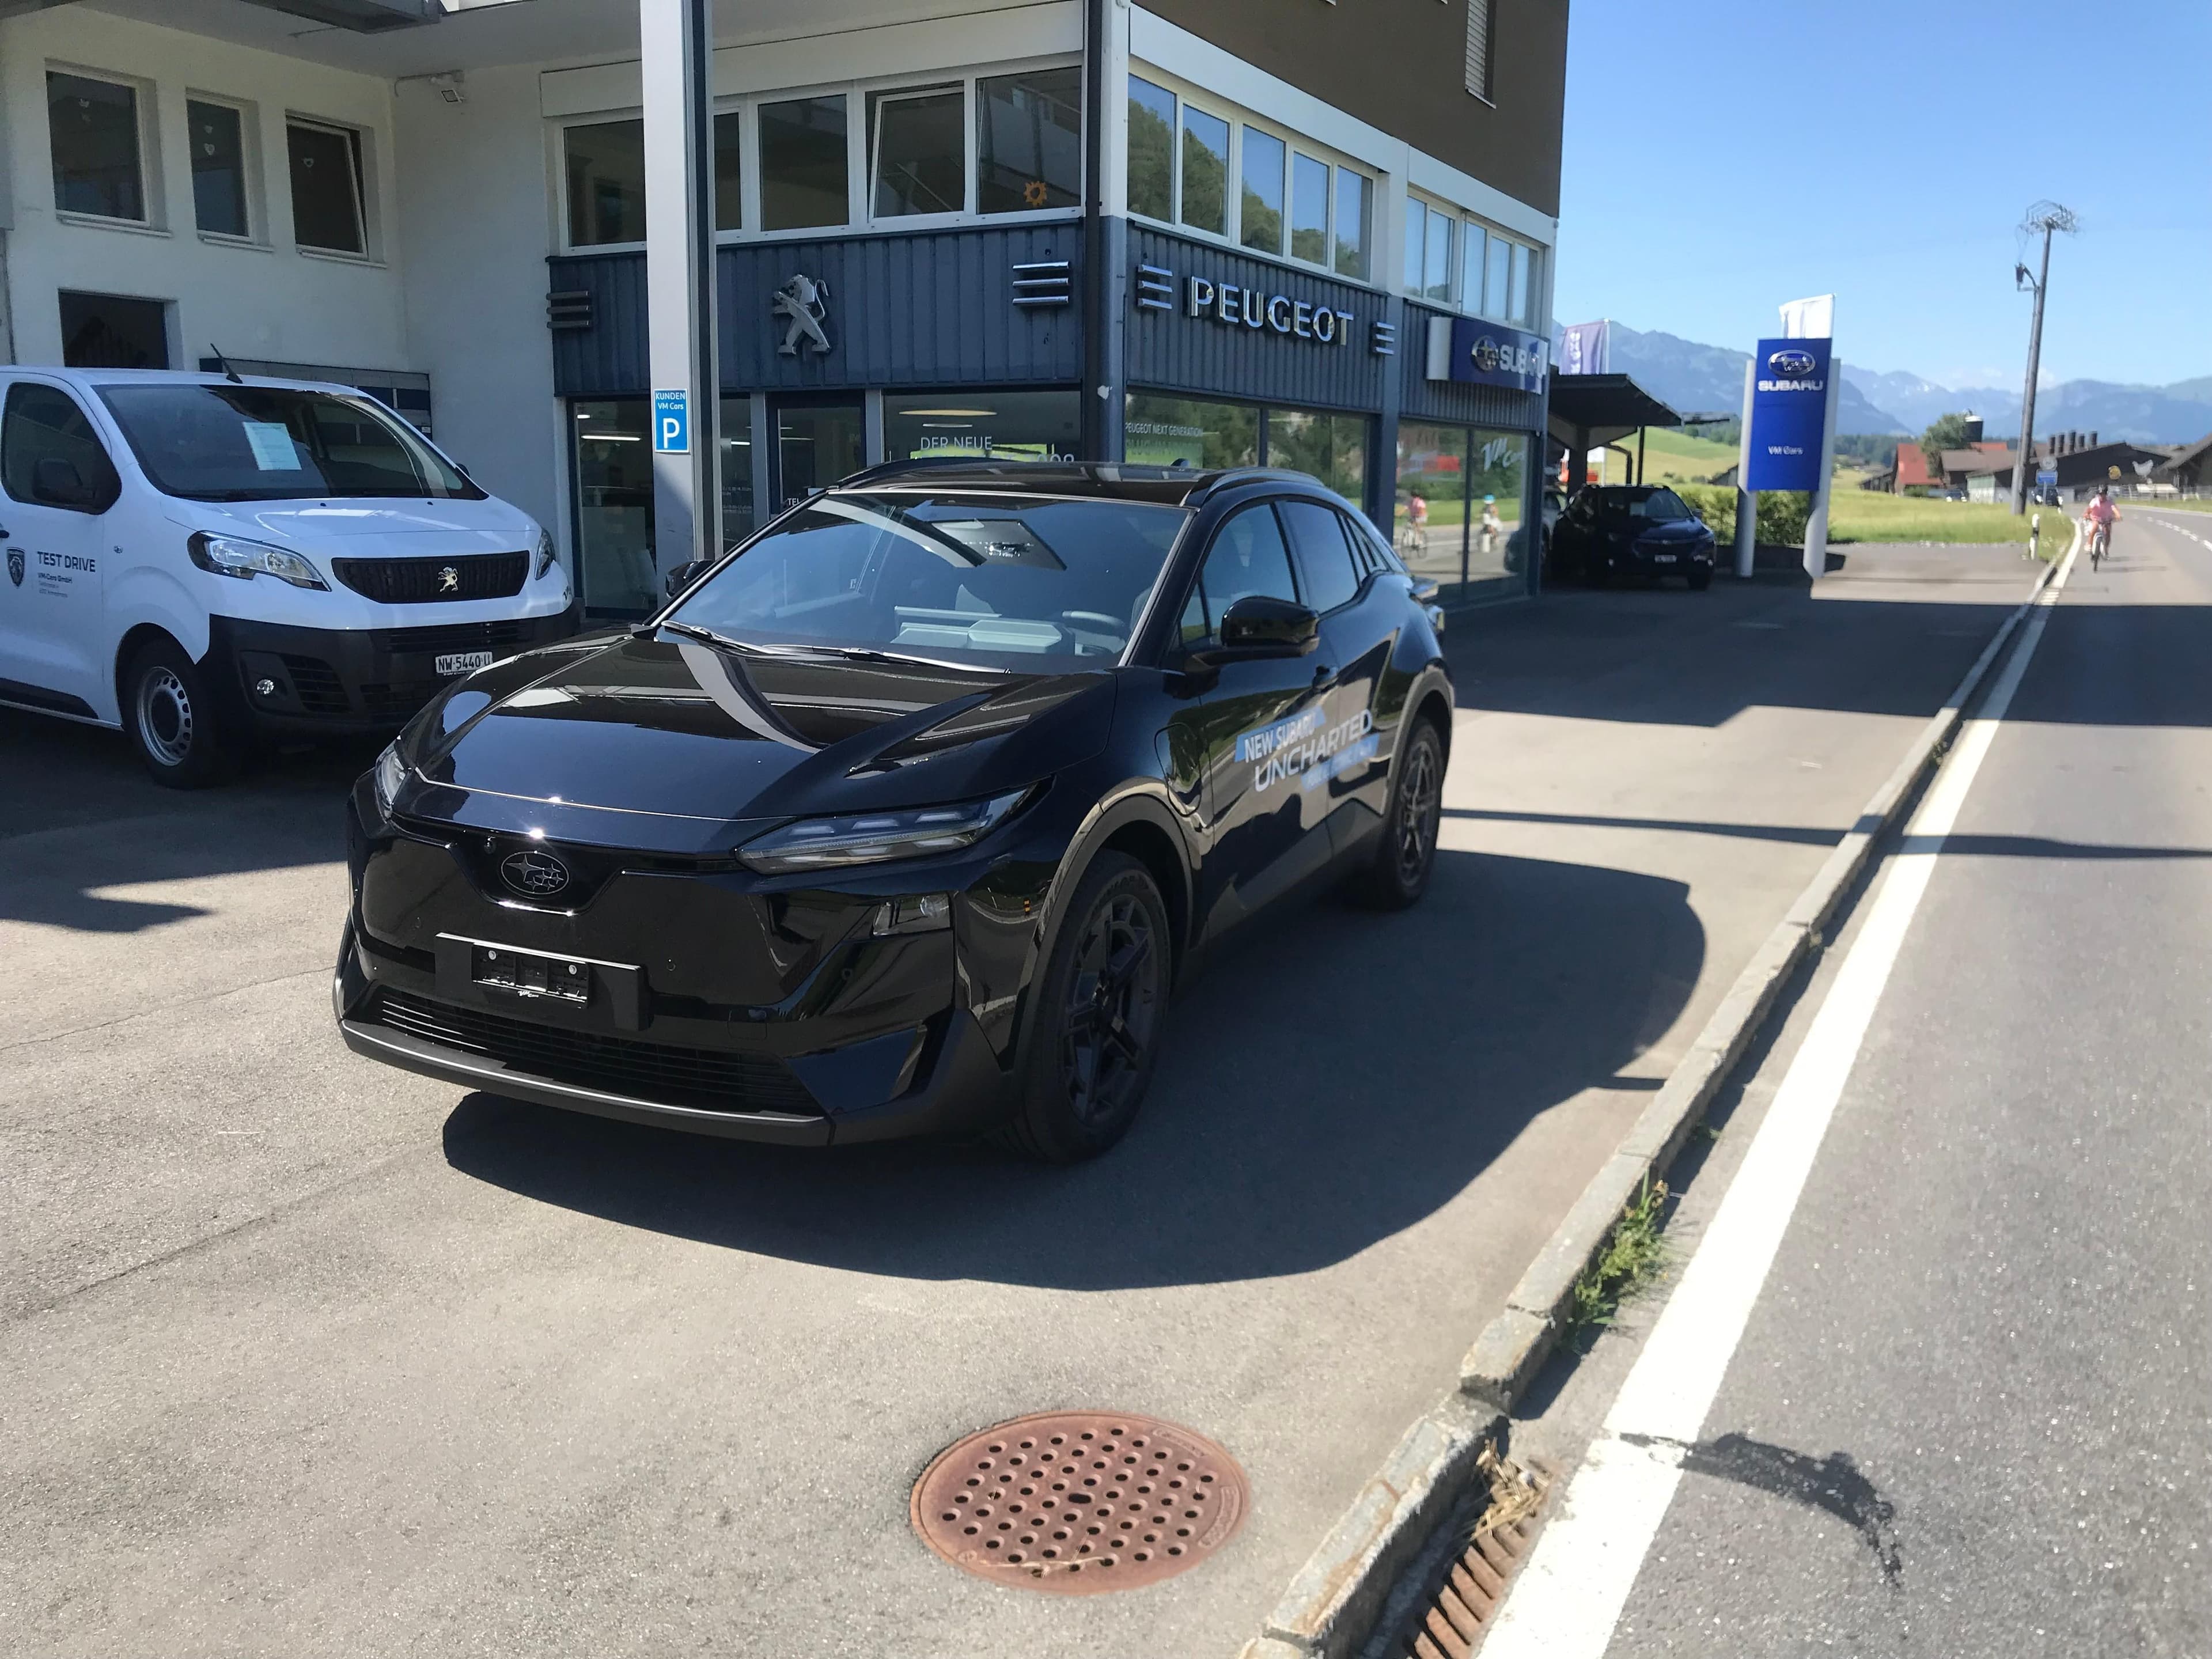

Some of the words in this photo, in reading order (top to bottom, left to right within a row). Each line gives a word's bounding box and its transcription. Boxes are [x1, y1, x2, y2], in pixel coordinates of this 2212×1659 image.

[1191, 275, 1354, 346] PEUGEOT
[1499, 344, 1548, 378] SUBU
[1758, 380, 1824, 391] SUBARU
[663, 418, 680, 449] P
[1768, 446, 1782, 455] VM
[37, 551, 62, 567] TEST
[65, 555, 96, 572] DRIVE
[1244, 730, 1274, 763] NEW
[1275, 710, 1316, 751] SUBARU
[1255, 709, 1373, 792] UNCHARTED
